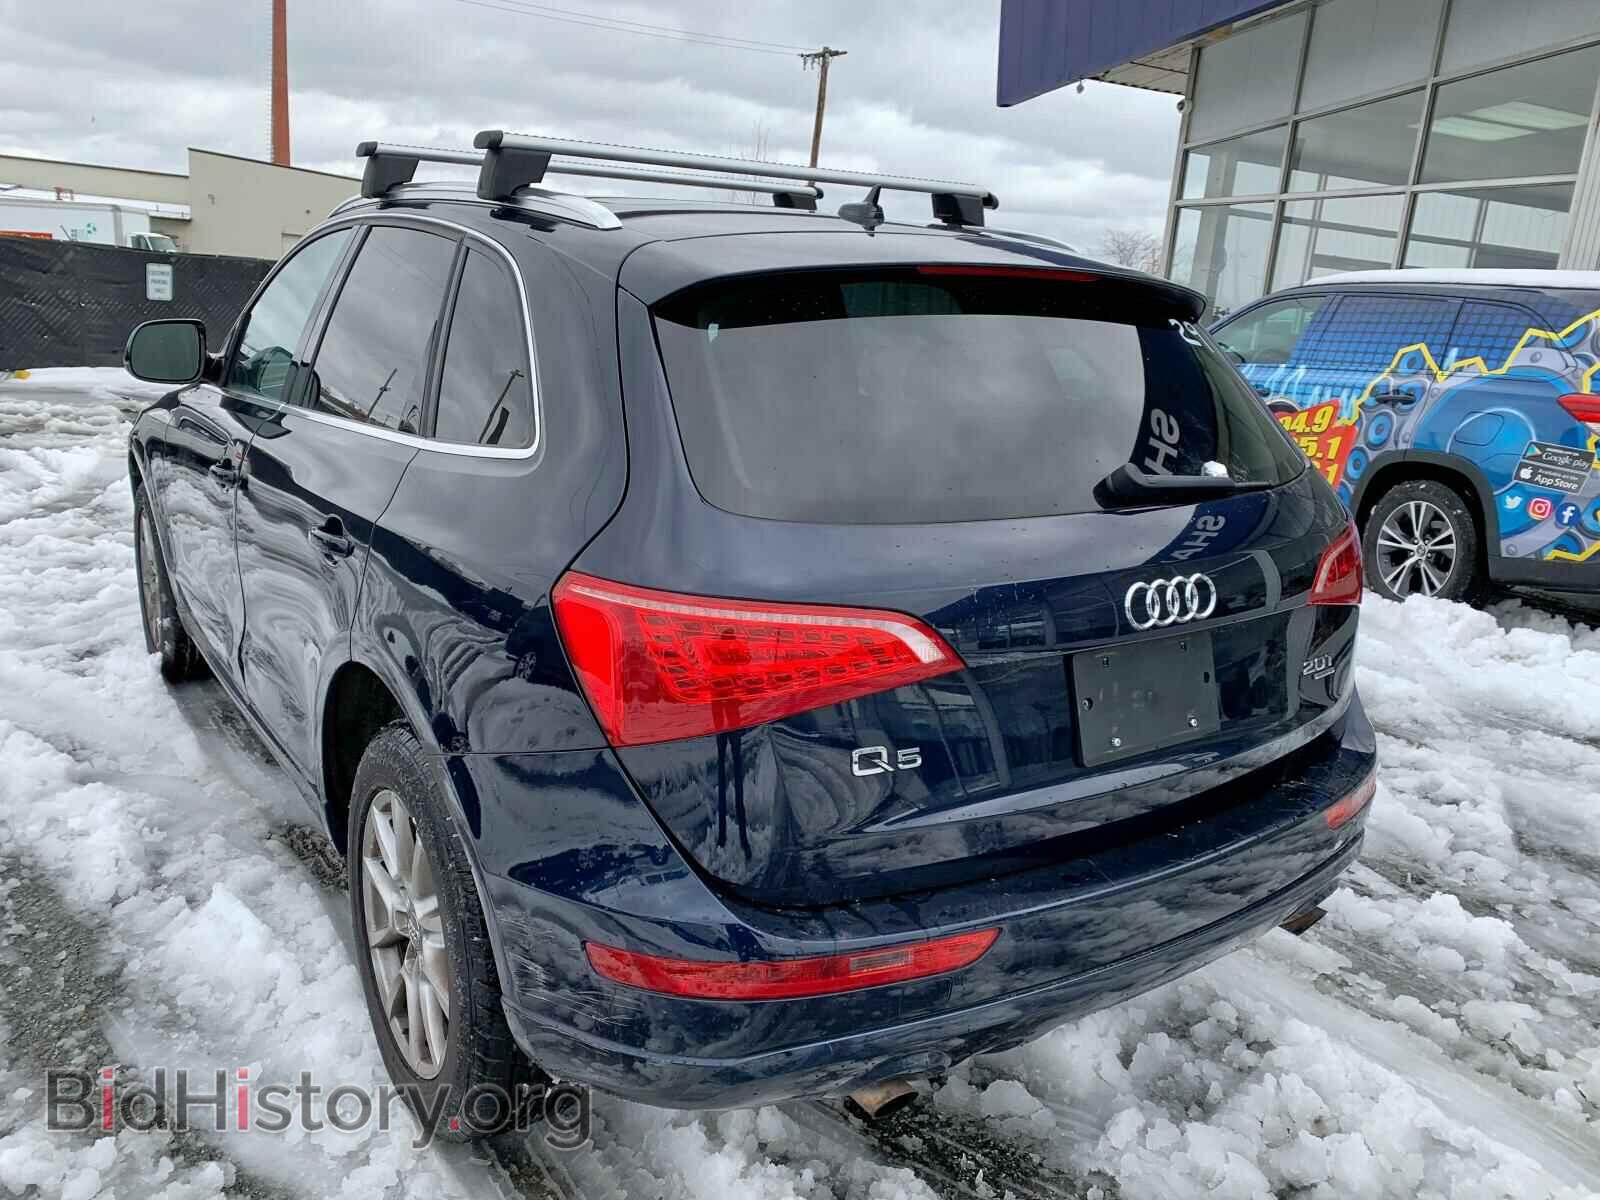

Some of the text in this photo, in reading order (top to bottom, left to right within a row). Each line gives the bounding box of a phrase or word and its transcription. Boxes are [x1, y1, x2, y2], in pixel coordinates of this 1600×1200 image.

[1293, 437, 1341, 460] 5.1
[1534, 474, 1553, 487] App
[1553, 478, 1579, 490] Store
[852, 746, 922, 776] Q5
